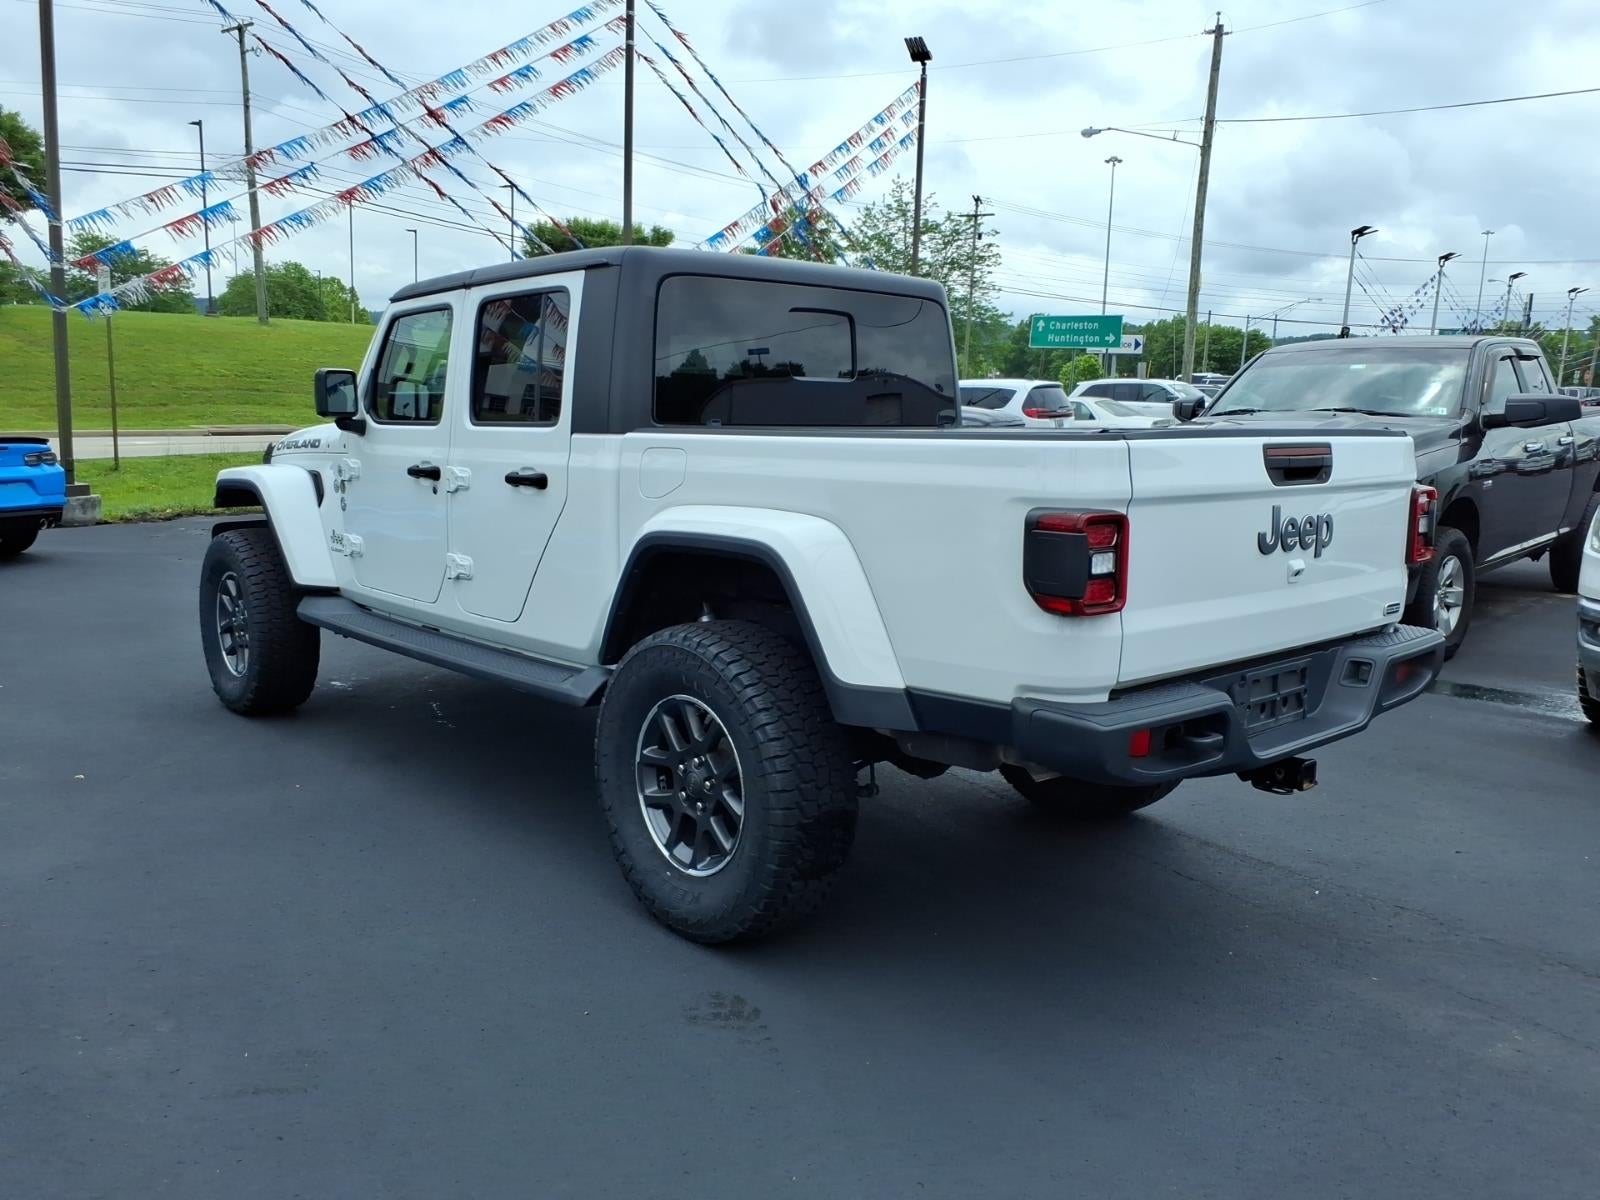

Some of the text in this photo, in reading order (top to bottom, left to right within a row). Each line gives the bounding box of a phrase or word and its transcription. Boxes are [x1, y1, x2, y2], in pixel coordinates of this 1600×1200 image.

[1049, 320, 1099, 330] Charleston
[1048, 334, 1100, 344] Huntington
[276, 439, 321, 450] OVERLAND
[1258, 505, 1333, 558] Jeep
